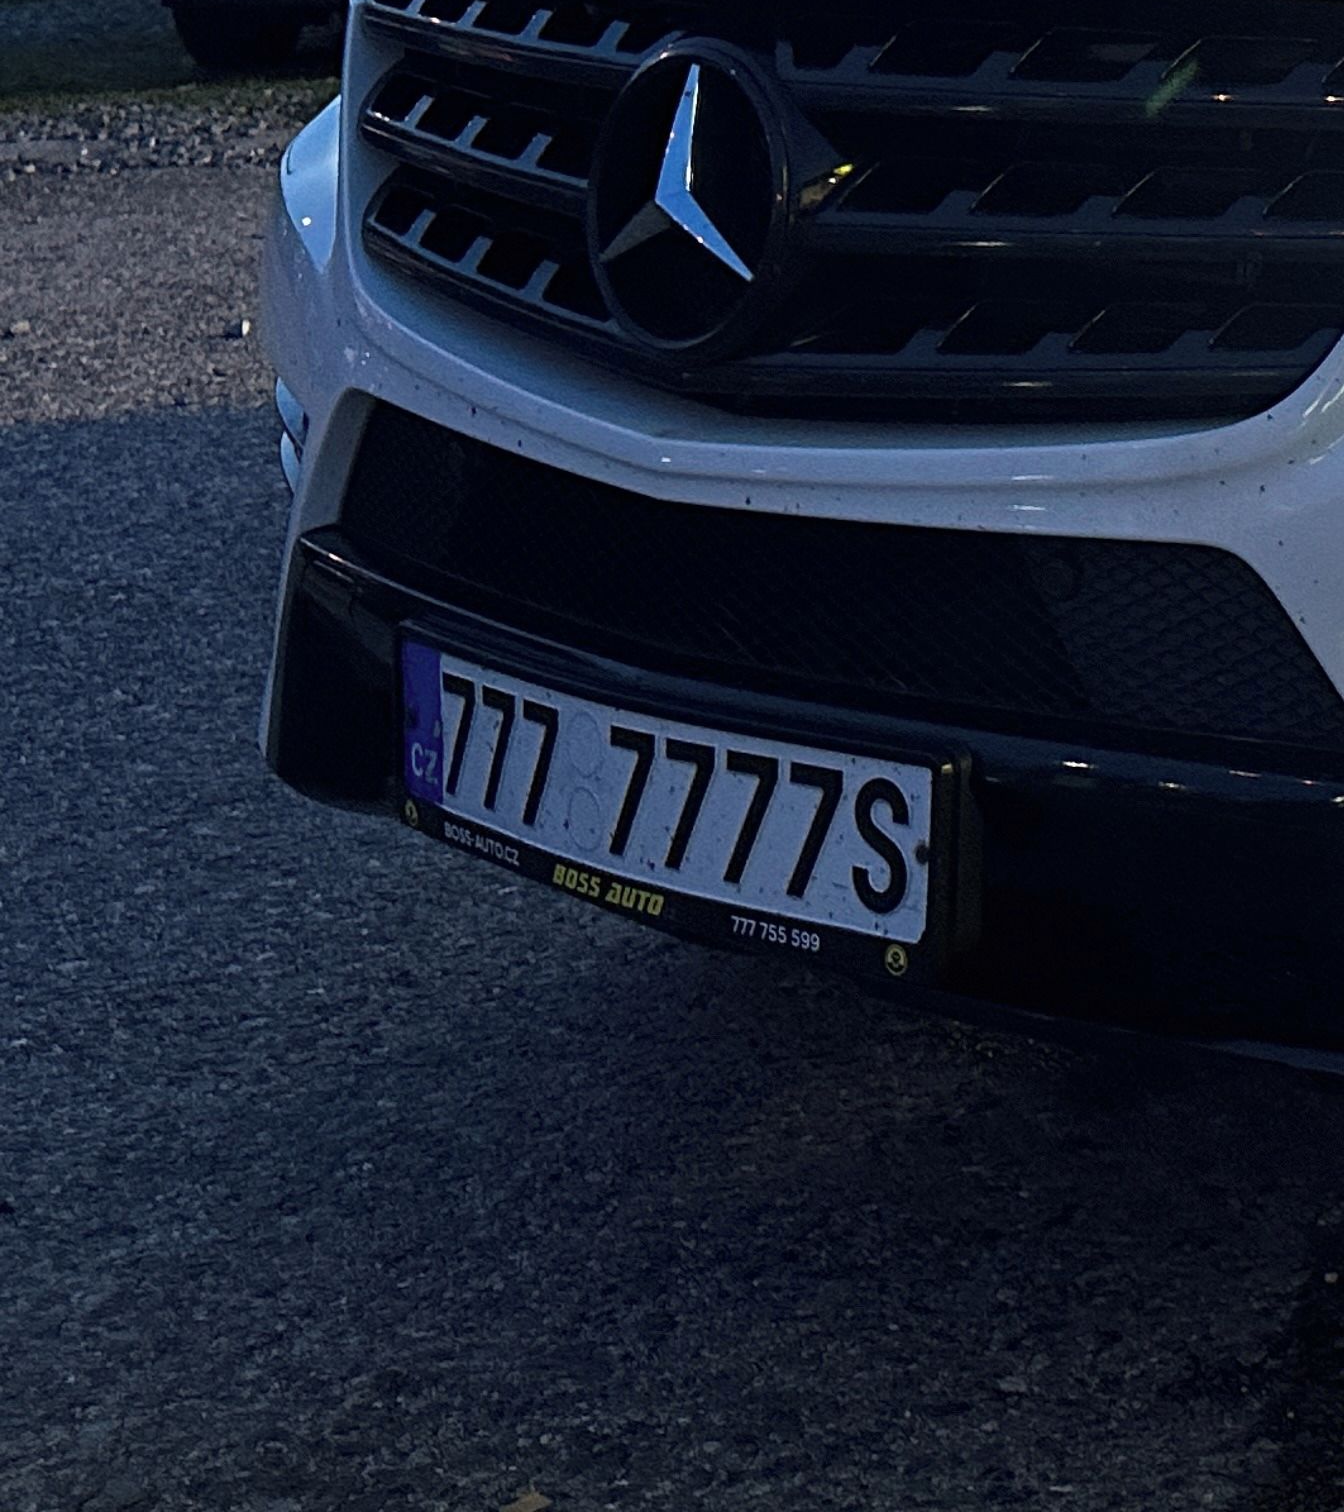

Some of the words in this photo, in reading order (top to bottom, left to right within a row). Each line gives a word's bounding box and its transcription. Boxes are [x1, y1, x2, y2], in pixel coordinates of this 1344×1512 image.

[411, 741, 439, 785] CZ
[442, 671, 559, 827] 777
[608, 724, 911, 915] 7777S
[443, 821, 521, 867] BOSS-AUTO.CZ
[552, 863, 602, 899] BOSS
[605, 881, 666, 917] AUTO
[731, 915, 757, 937] 777
[759, 922, 788, 944] 755
[791, 929, 821, 953] 599
